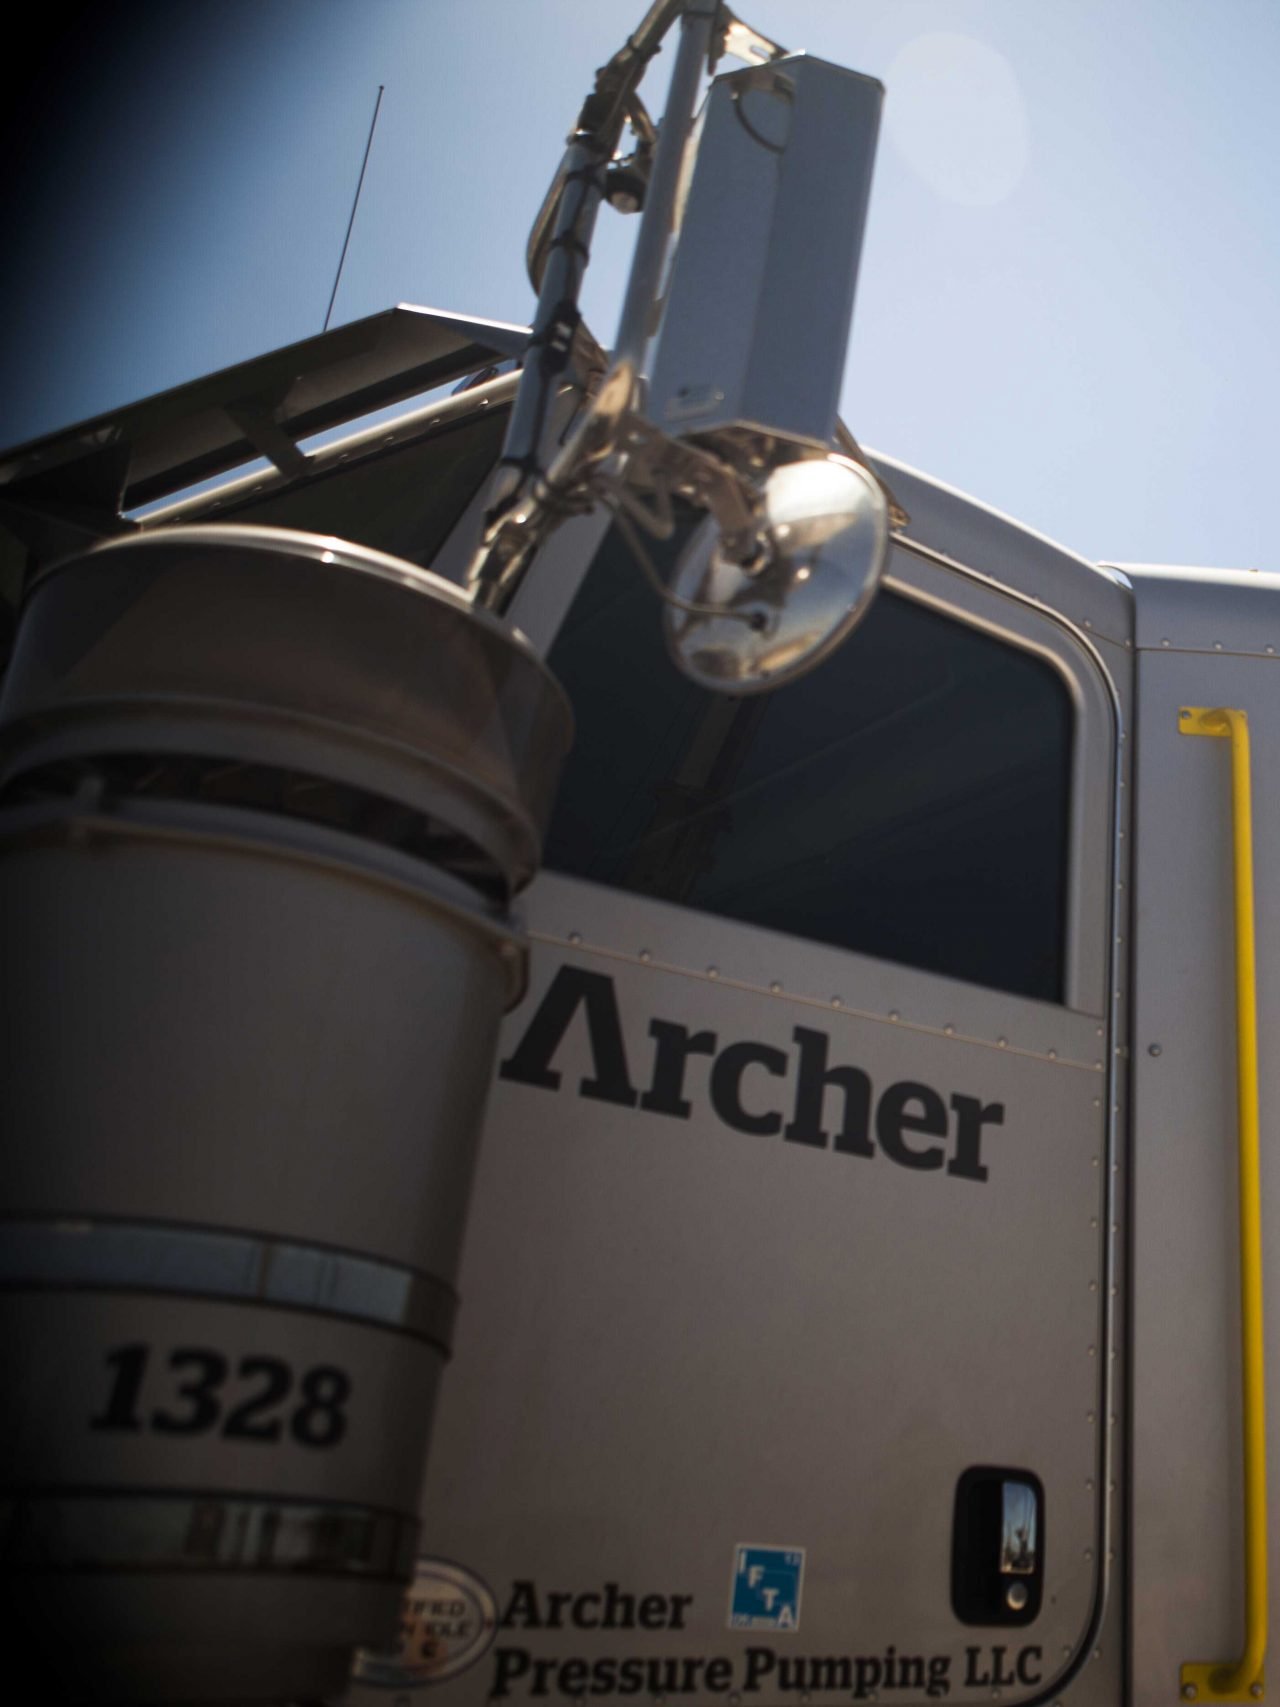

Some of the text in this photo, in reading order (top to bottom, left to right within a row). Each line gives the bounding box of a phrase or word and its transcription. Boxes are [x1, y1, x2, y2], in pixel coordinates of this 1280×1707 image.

[500, 964, 1004, 1182] Archer
[90, 1343, 350, 1448] 1328
[502, 1582, 693, 1630] Archer
[492, 1647, 1042, 1697] Pressure Pumping LLC
